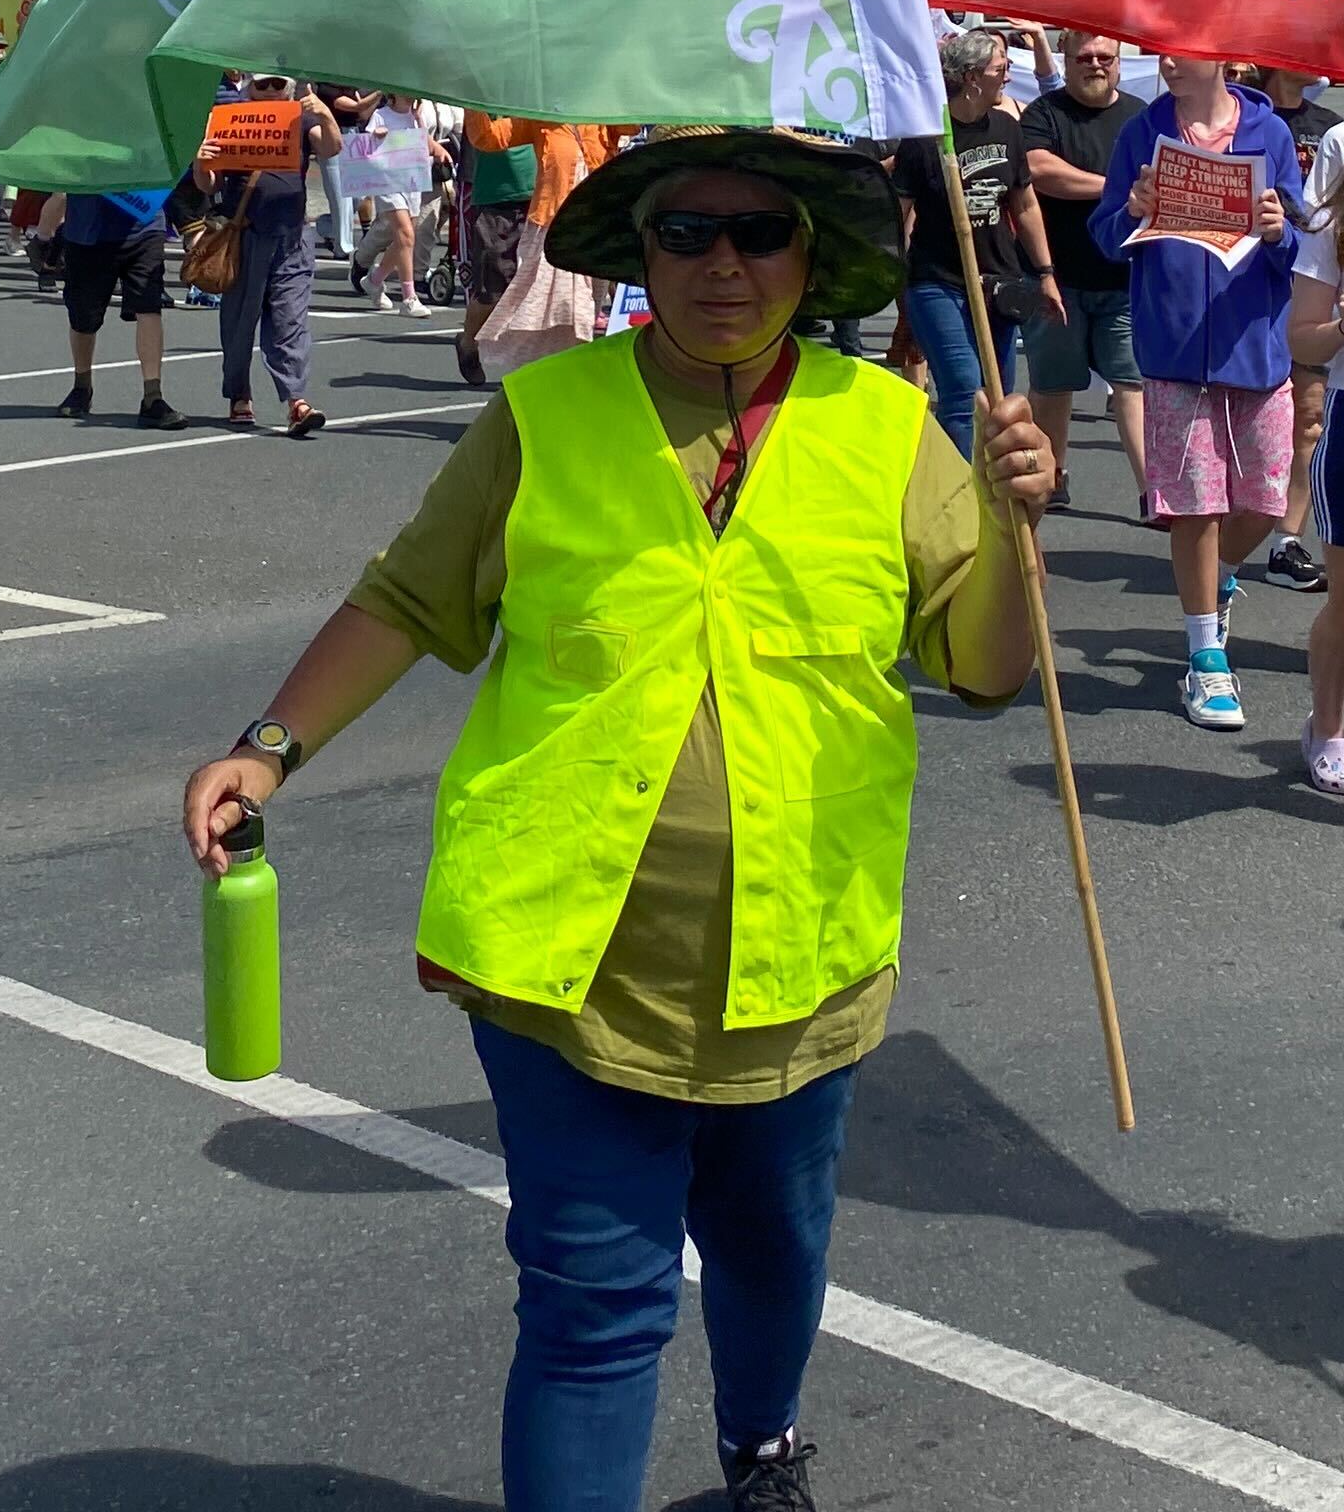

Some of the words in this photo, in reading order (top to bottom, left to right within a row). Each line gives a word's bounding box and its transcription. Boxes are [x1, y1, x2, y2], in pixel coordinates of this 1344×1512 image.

[214, 128, 262, 140] HEALTH
[265, 128, 291, 140] FOR
[221, 144, 236, 156] HE
[240, 145, 289, 156] PEOPLE
[1161, 150, 1176, 161] THE
[1177, 152, 1197, 165] FACT
[1160, 161, 1188, 178] KEEP
[1189, 169, 1248, 188] STRIKING
[1159, 176, 1186, 189] EVERY
[1195, 183, 1227, 196] YEARS
[1228, 187, 1248, 198] FOR
[1191, 193, 1221, 206] STAFF
[1160, 201, 1188, 214] MORE
[1190, 206, 1246, 224] RESOURCES
